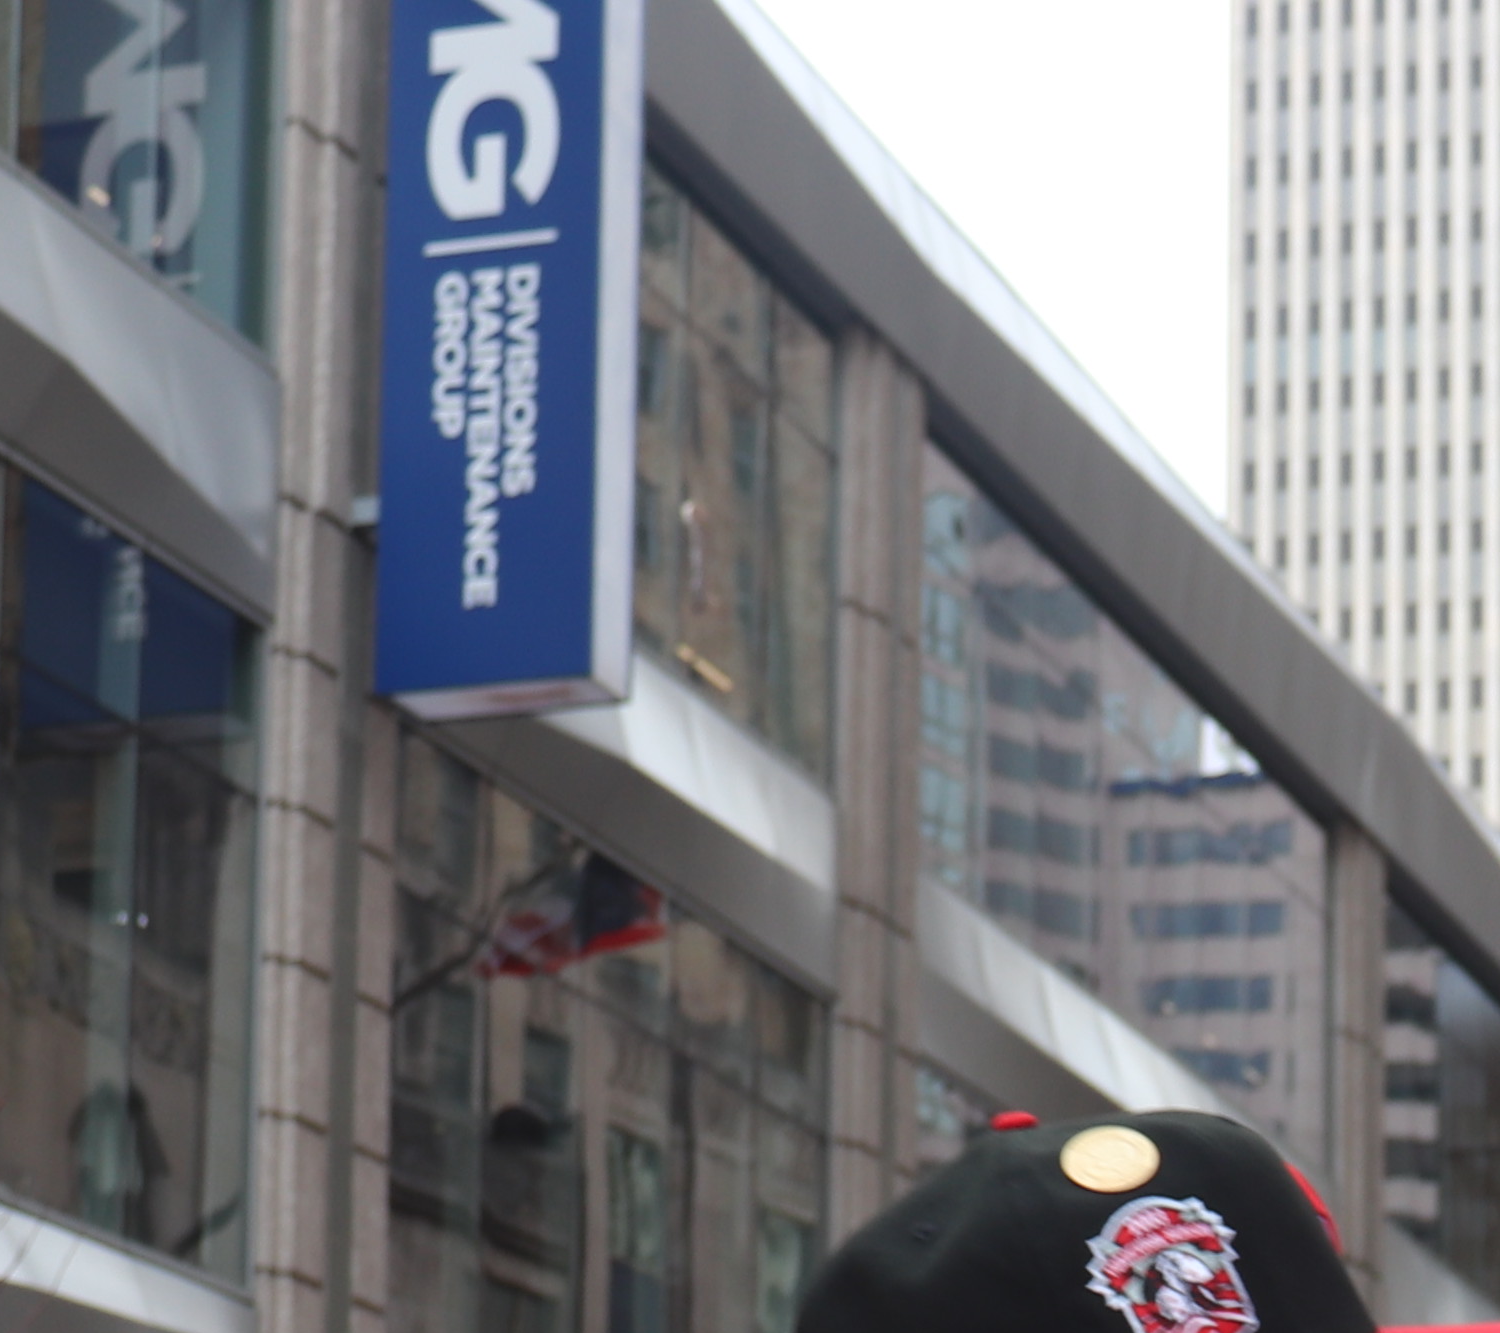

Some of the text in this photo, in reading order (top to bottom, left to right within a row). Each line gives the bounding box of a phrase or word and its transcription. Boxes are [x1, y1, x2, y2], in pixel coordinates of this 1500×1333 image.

[431, 270, 470, 439] GROUP
[462, 267, 504, 611] MAINTENANCE
[501, 262, 541, 498] DIVISIONS
